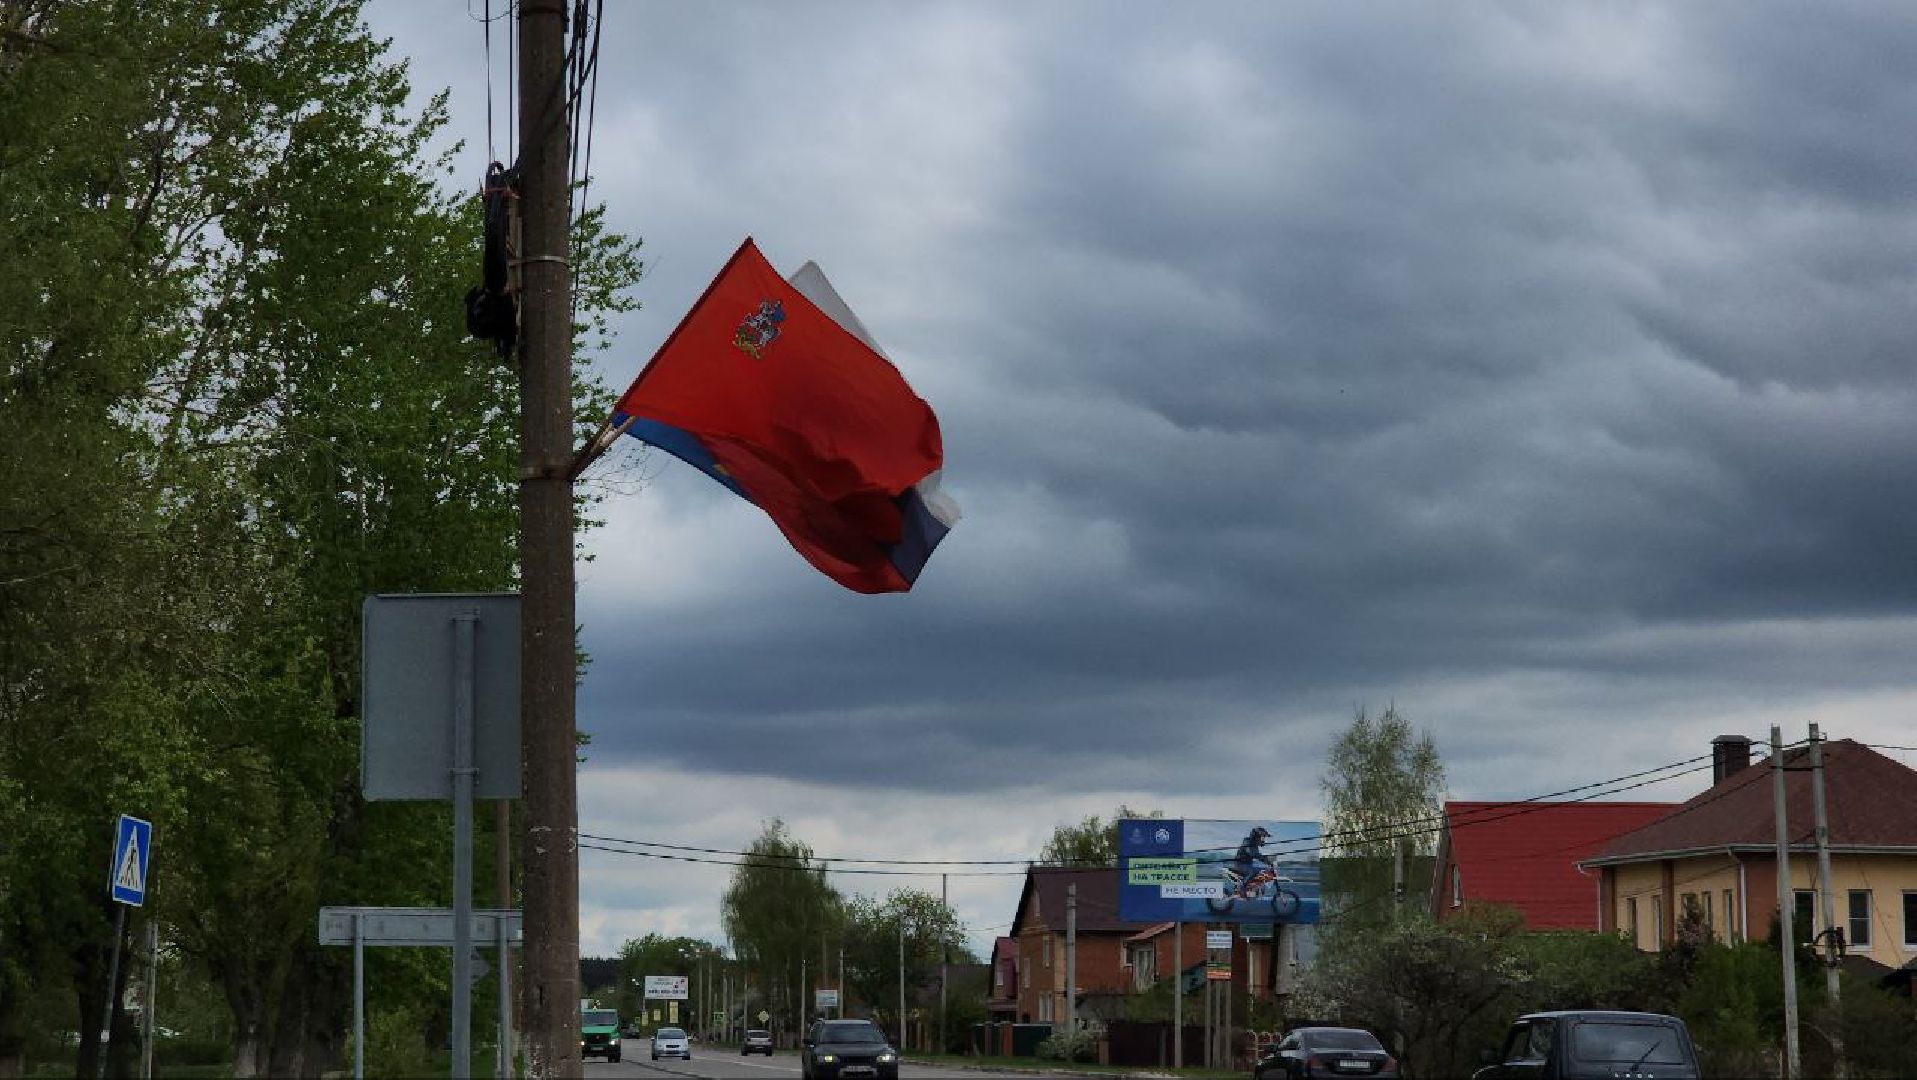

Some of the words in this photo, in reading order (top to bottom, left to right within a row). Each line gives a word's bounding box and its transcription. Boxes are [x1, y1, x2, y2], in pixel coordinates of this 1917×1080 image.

[1134, 873, 1148, 881] НА
[1150, 873, 1190, 881] ТРАССЕ
[1165, 887, 1179, 895] НЕ
[1182, 887, 1217, 895] МЕСТО
